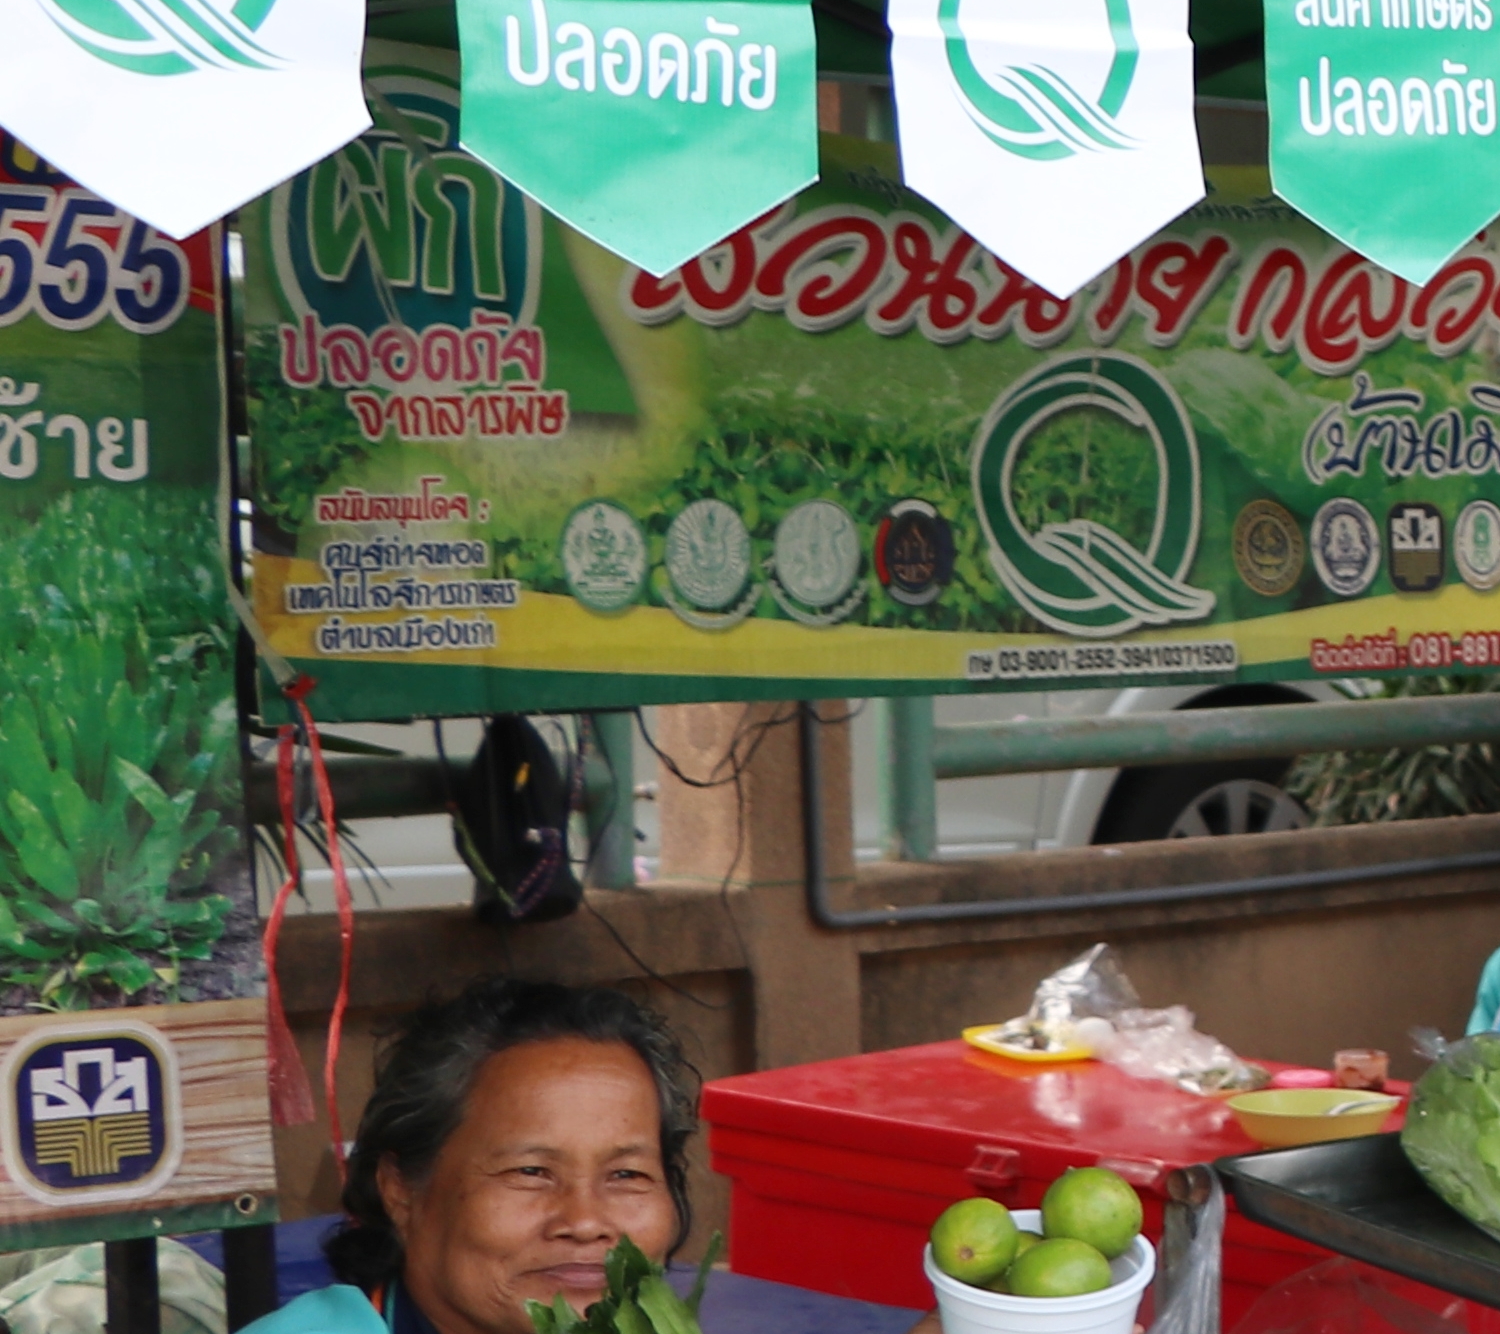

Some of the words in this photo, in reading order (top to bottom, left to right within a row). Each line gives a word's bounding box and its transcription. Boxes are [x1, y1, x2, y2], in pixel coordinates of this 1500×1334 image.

[1300, 57, 1497, 136] ปลอดภัย
[284, 313, 543, 385] ปลอดภัย
[352, 385, 565, 437] จากสารพิษ
